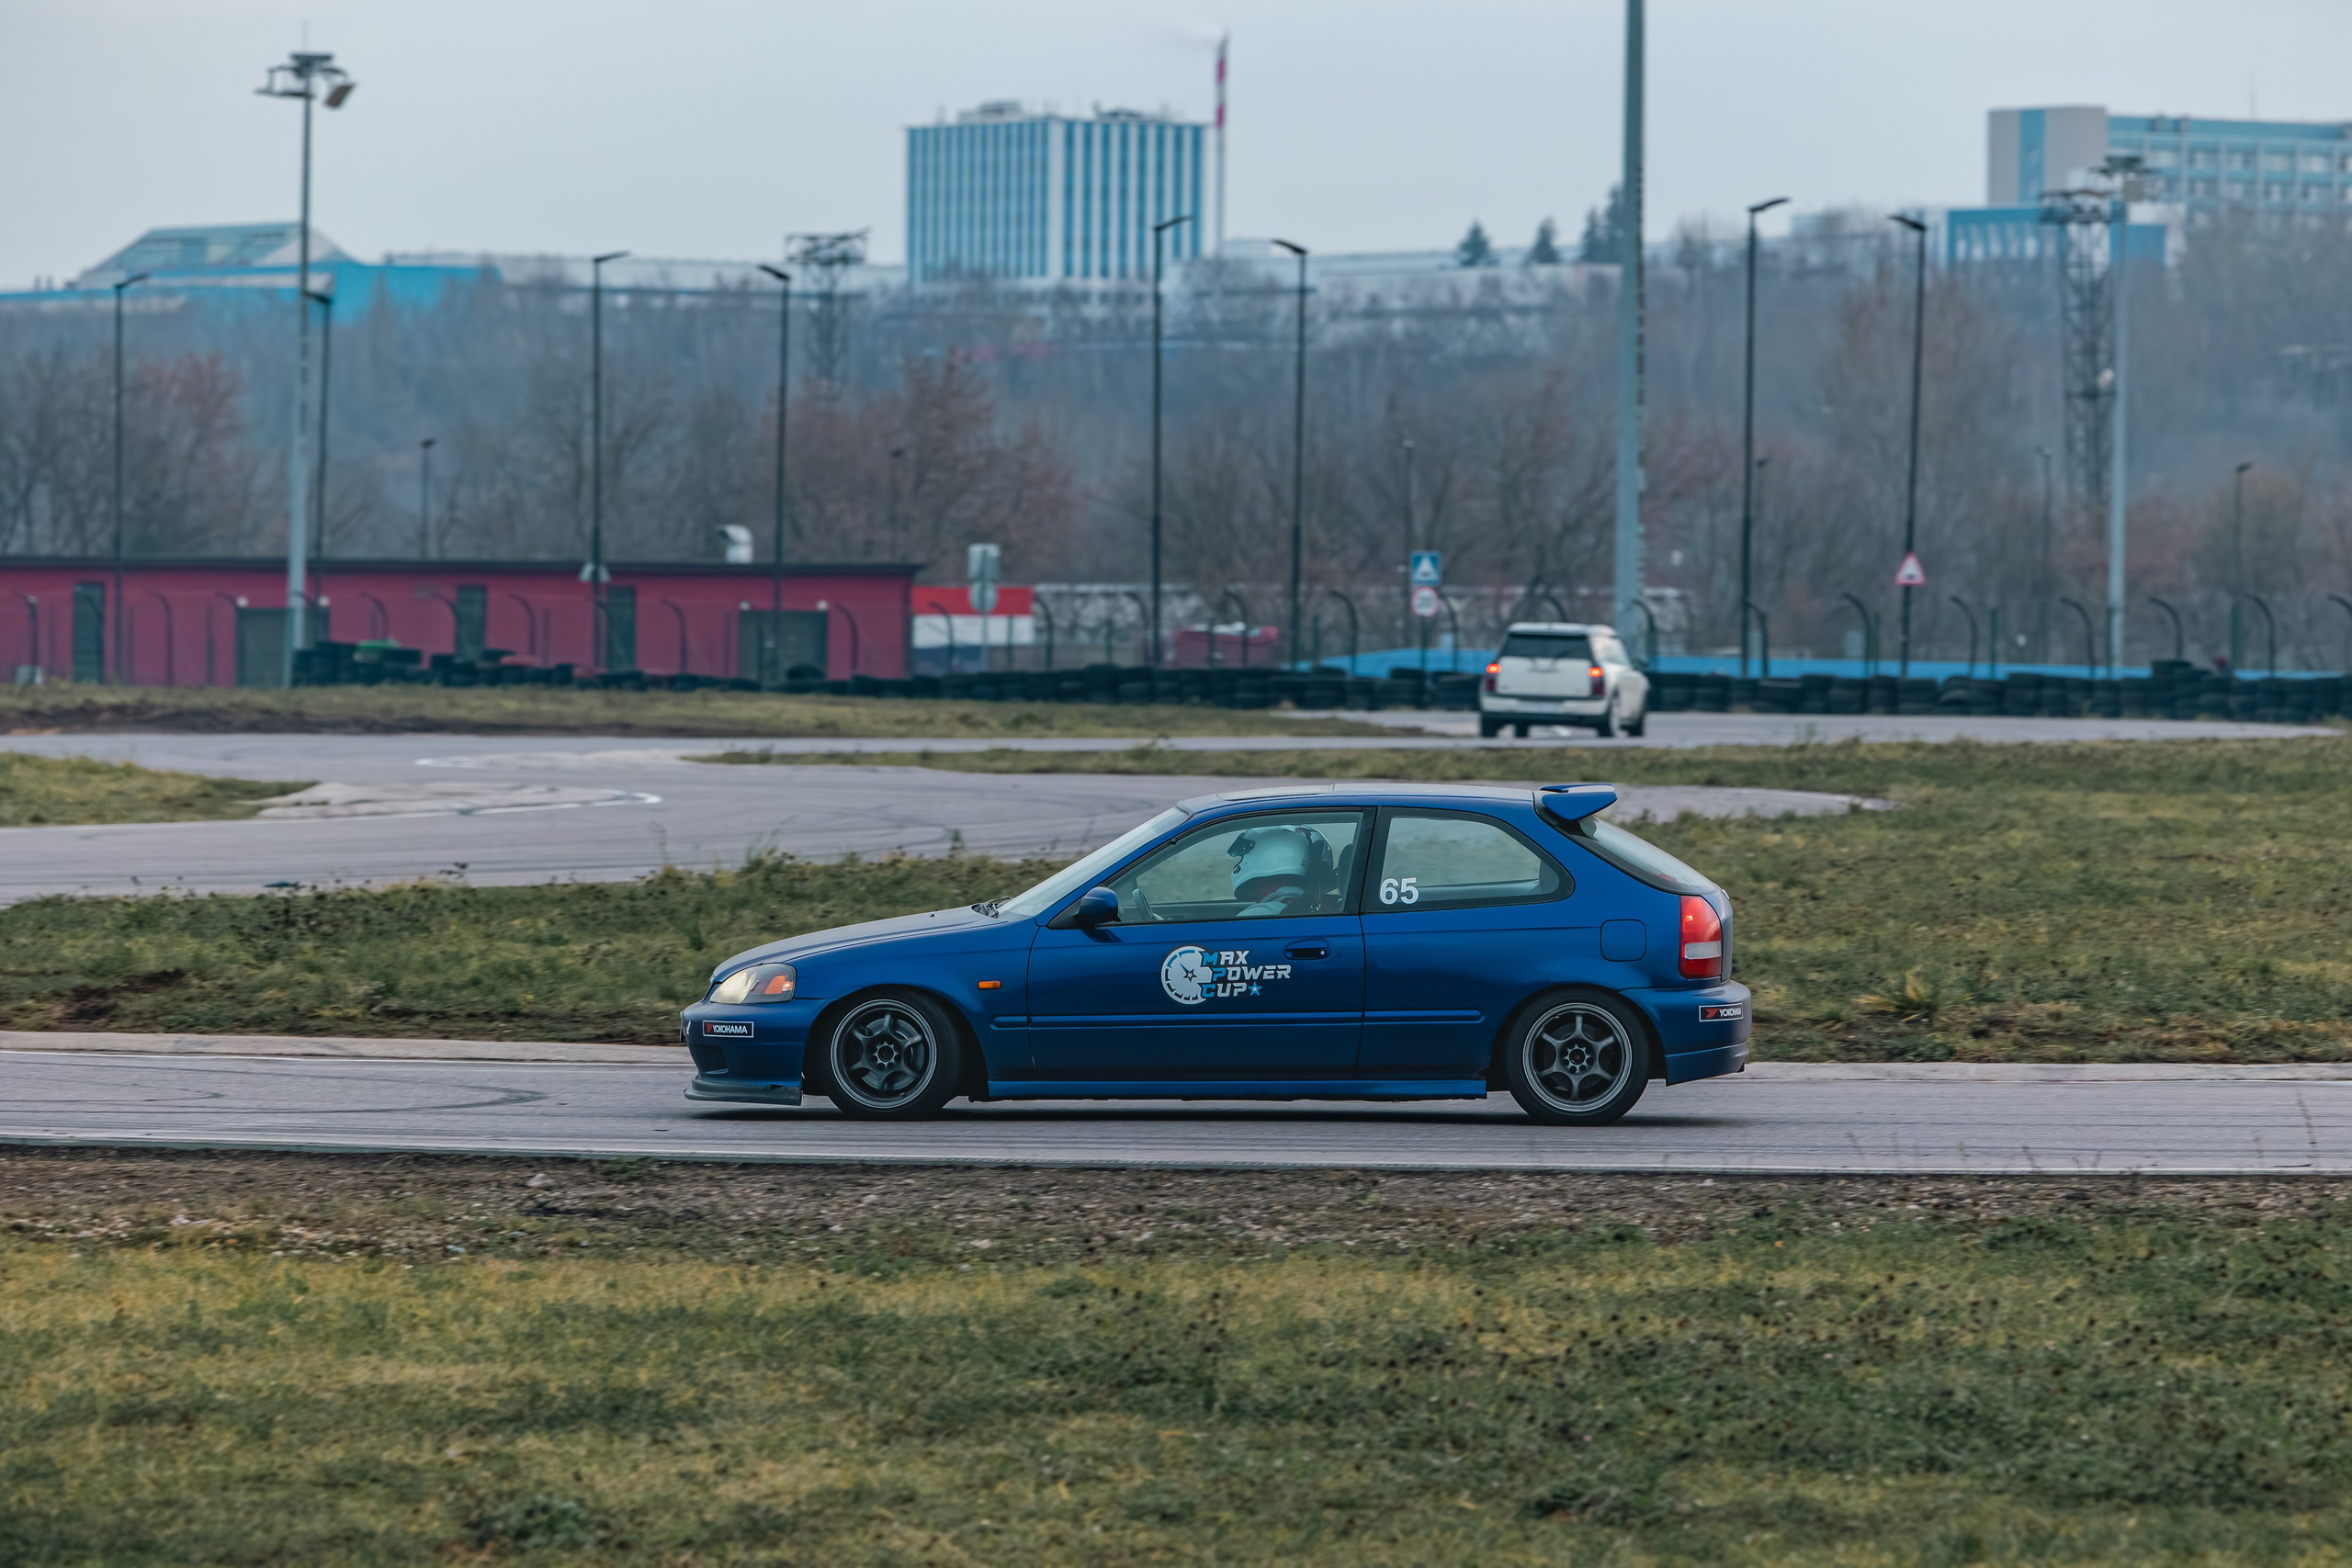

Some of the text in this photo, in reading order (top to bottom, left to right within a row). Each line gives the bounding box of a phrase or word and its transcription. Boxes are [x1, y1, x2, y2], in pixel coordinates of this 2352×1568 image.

[1380, 877, 1419, 905] 65
[1202, 951, 1250, 965] MAX
[1212, 964, 1292, 981] POWER
[1201, 983, 1248, 998] CUP
[712, 1024, 748, 1034] YOKOHAMA
